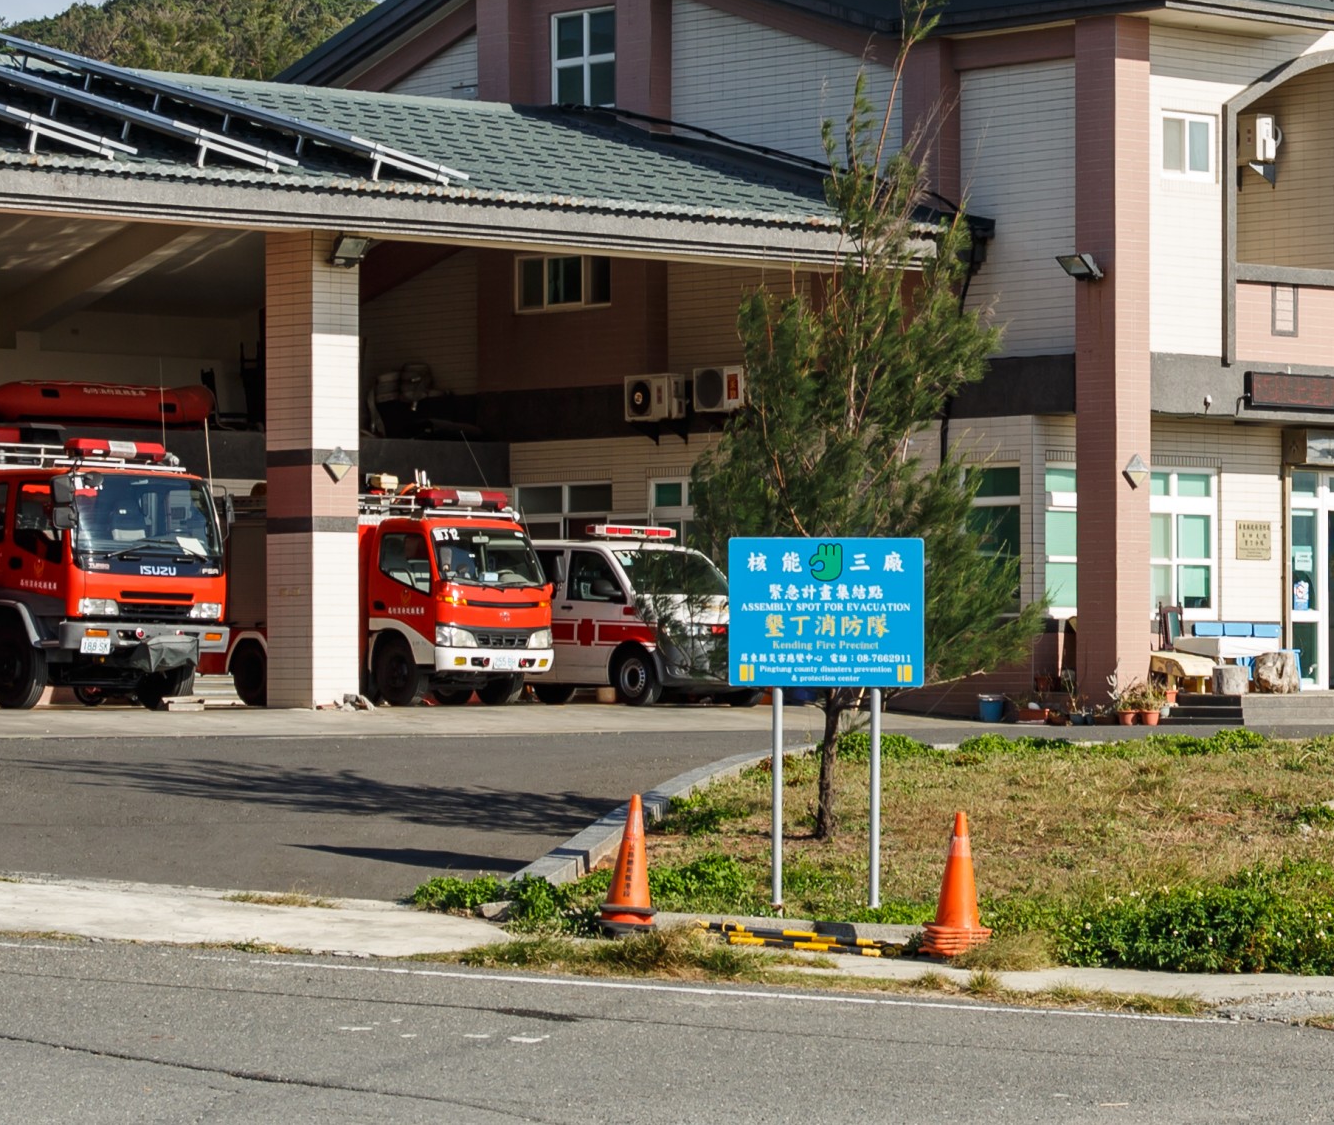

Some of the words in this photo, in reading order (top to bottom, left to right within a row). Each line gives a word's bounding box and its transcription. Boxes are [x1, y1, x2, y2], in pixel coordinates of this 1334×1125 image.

[140, 565, 177, 576] ISUZU
[768, 584, 883, 600] 緊急計畫集結點
[741, 603, 793, 612] ASSEMBLY
[796, 603, 822, 612] SPOT
[824, 603, 843, 612] FOR
[846, 603, 911, 612] EVACUATION
[765, 613, 890, 638] 墾丁消防隊
[772, 640, 813, 650] Kending
[816, 640, 836, 649] Fire
[839, 640, 879, 649] Precinct
[759, 665, 792, 674] Pingtung
[794, 666, 818, 674] county
[820, 665, 852, 673] disasters
[854, 665, 892, 674] prevention
[800, 675, 836, 683] protection
